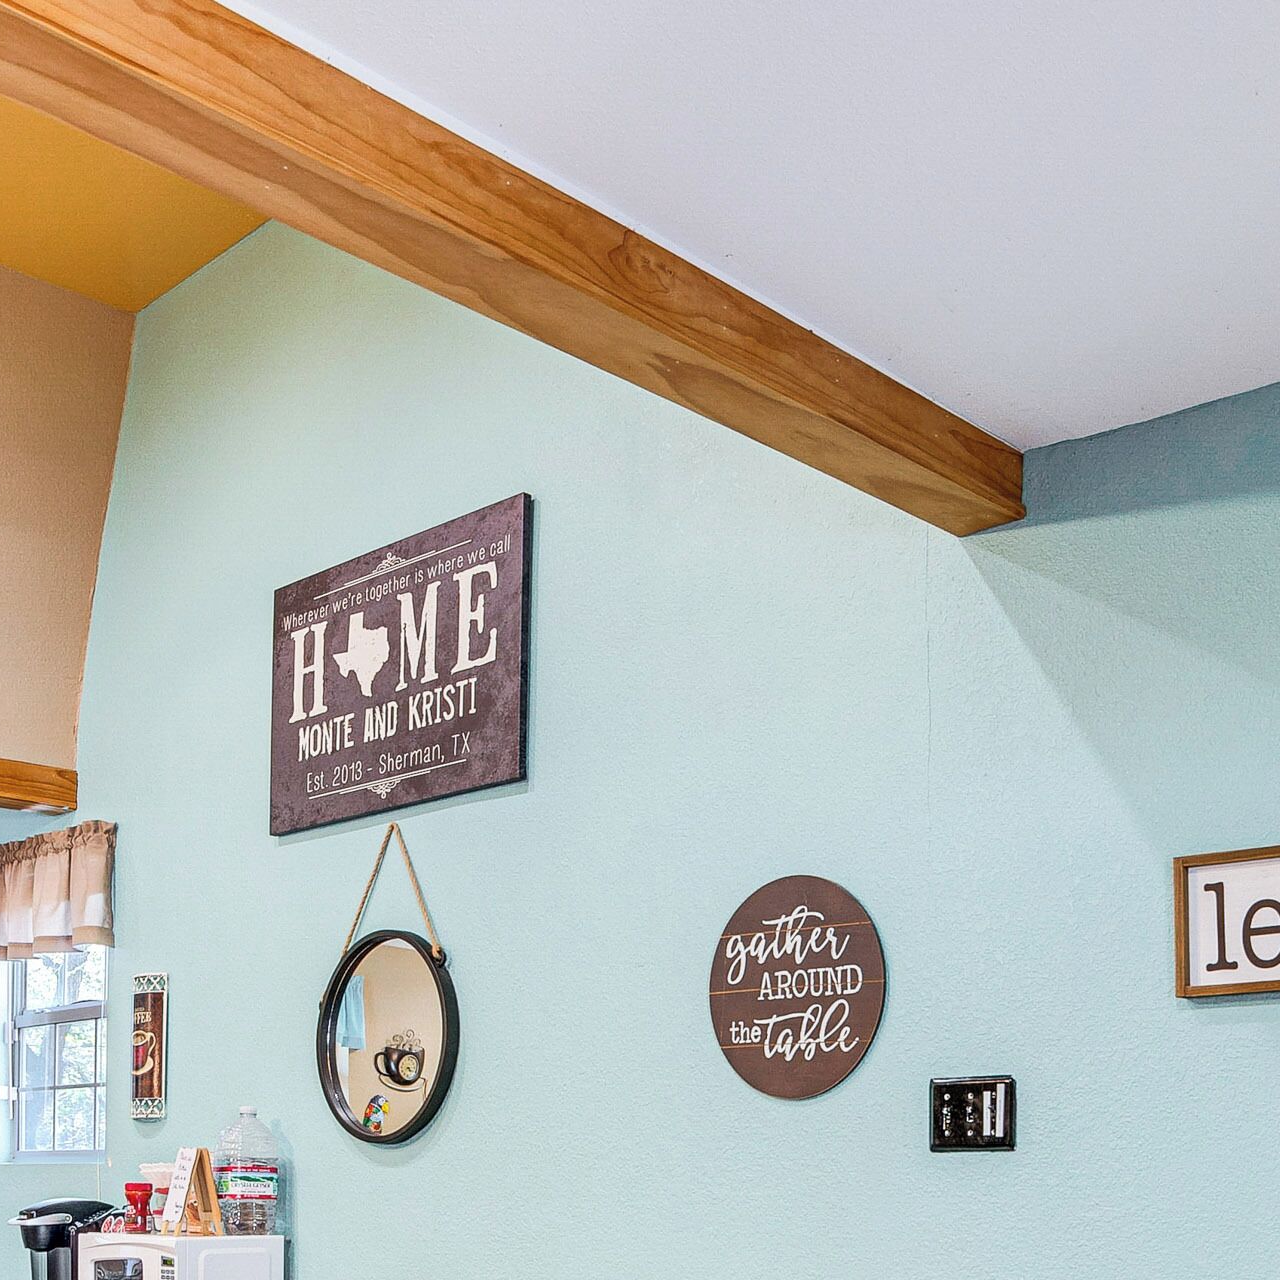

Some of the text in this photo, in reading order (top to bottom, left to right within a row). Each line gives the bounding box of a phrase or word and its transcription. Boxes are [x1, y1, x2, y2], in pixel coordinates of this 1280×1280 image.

[282, 533, 511, 631] Wherever we're together is where we call
[297, 677, 477, 762] MONTE AND KRISTI
[306, 771, 329, 793] Est.
[332, 760, 363, 786] 2013
[379, 743, 445, 774] Sherman,
[451, 731, 471, 756] TX
[725, 905, 851, 985] gather
[757, 963, 863, 1001] AROUND
[729, 999, 860, 1061] the table
